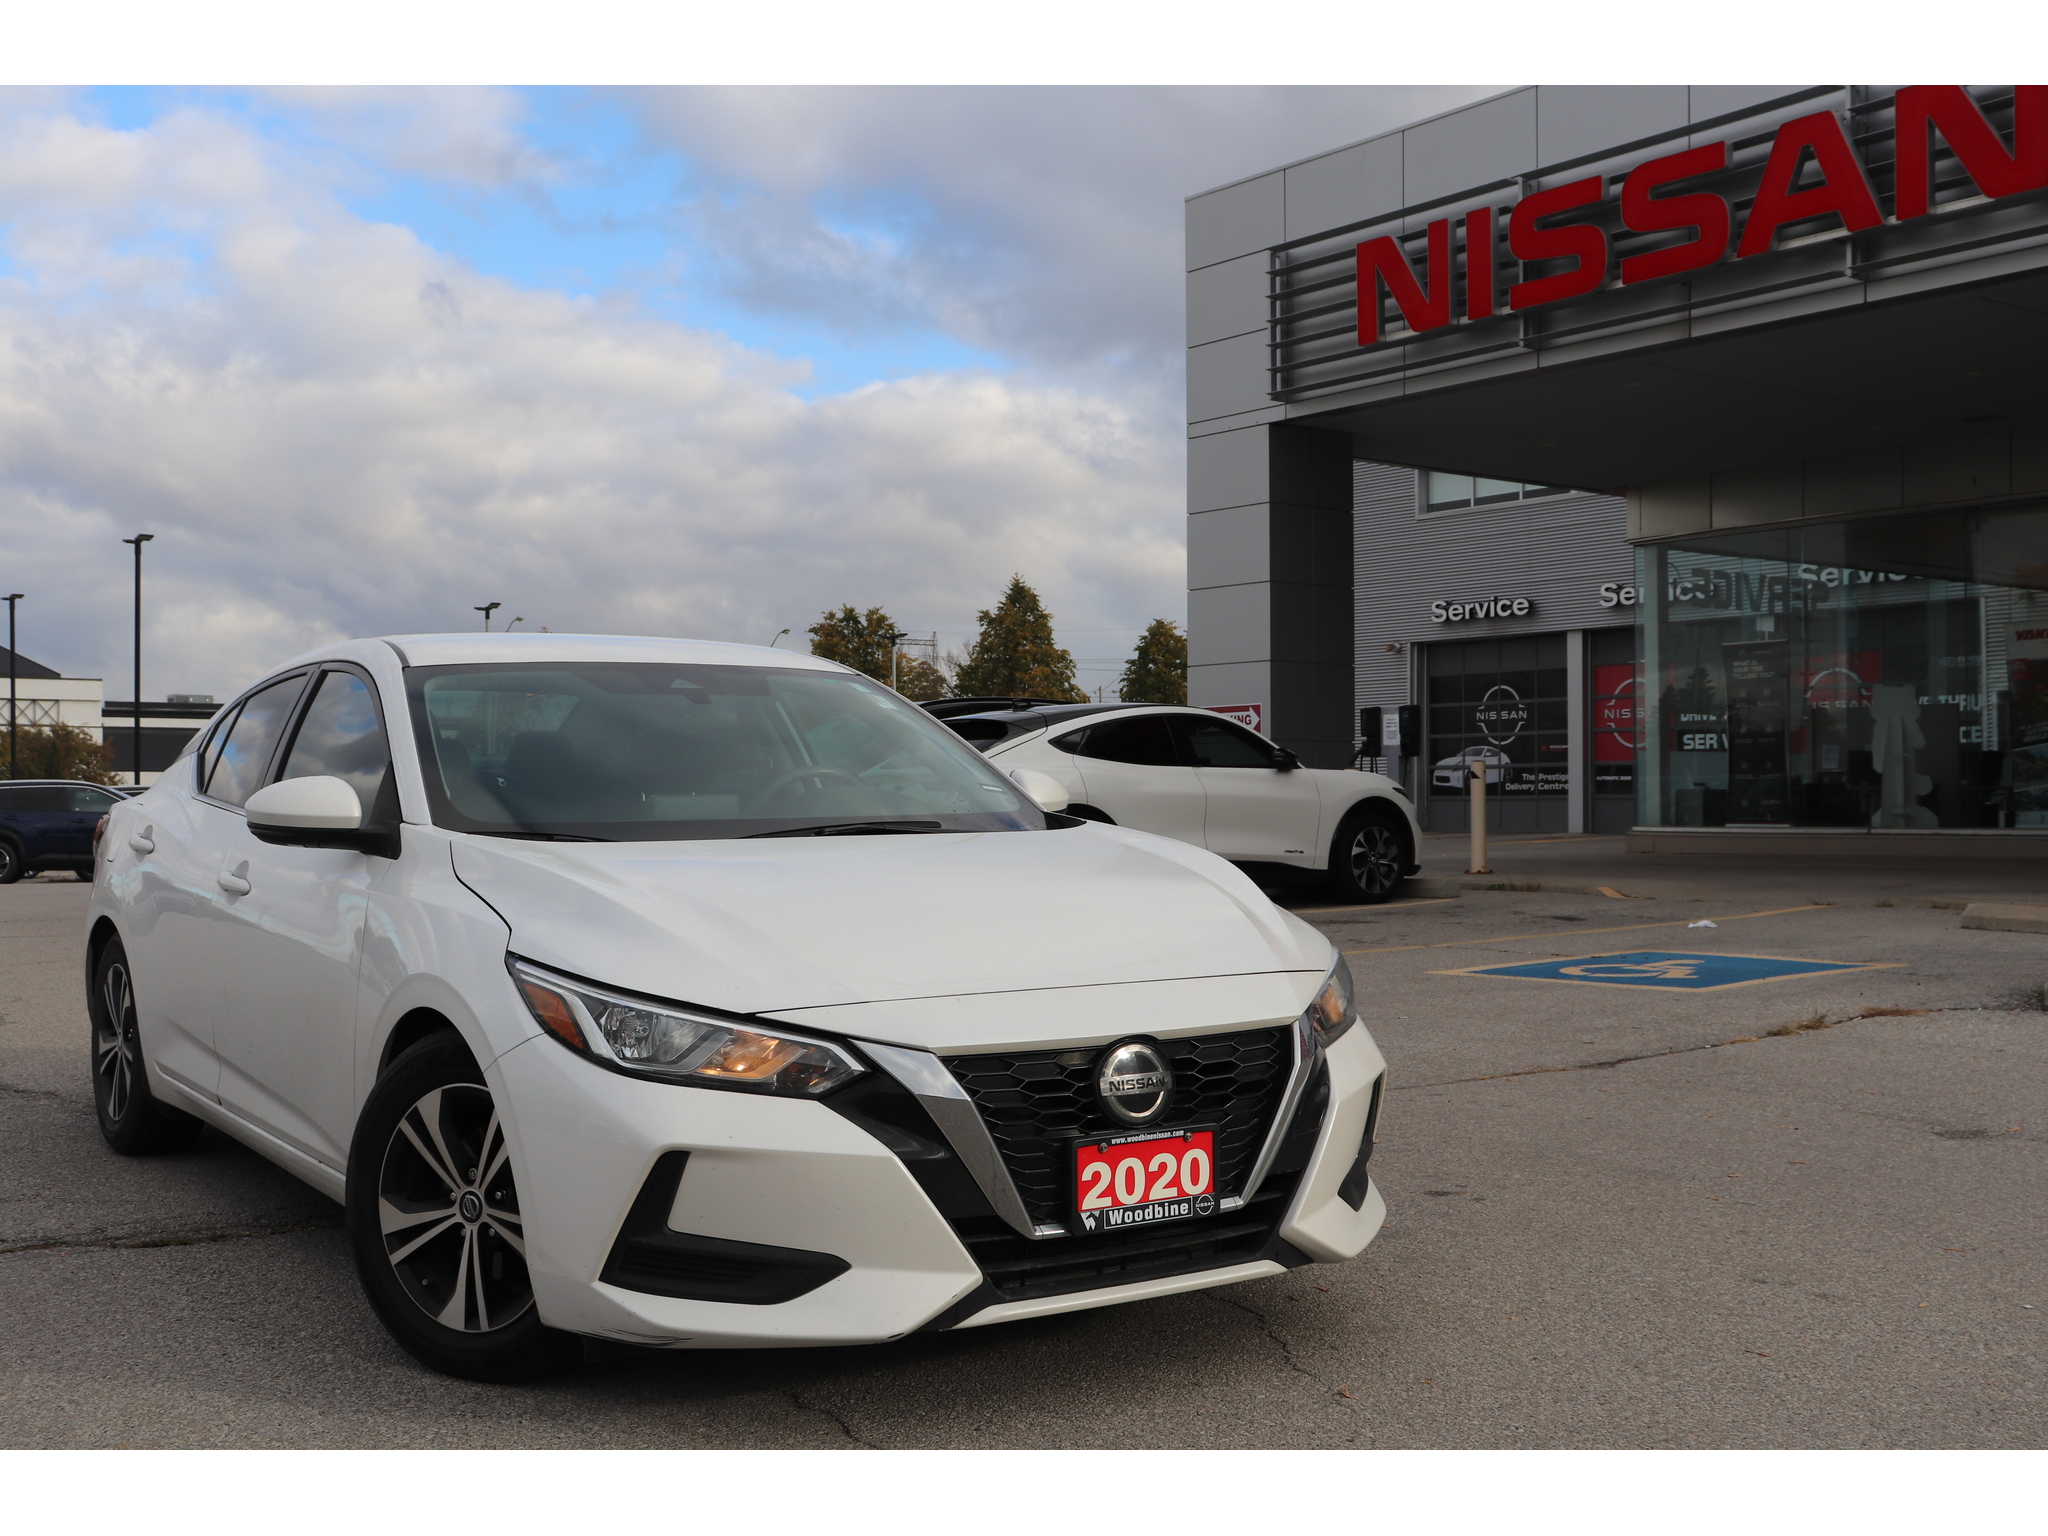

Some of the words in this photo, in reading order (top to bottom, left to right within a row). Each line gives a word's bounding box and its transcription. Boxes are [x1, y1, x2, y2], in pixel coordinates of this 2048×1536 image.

[1356, 85, 2048, 347] NISSAN
[1431, 597, 1530, 623] Service
[1476, 710, 1527, 720] NISSAN
[1522, 773, 1536, 781] The
[1505, 782, 1535, 791] Delivery
[1109, 1076, 1166, 1093] NISSAN
[1111, 1130, 1185, 1145] www.woodbinenissan.com
[1081, 1148, 1210, 1211] 2020
[1108, 1201, 1190, 1226] Woodbine
